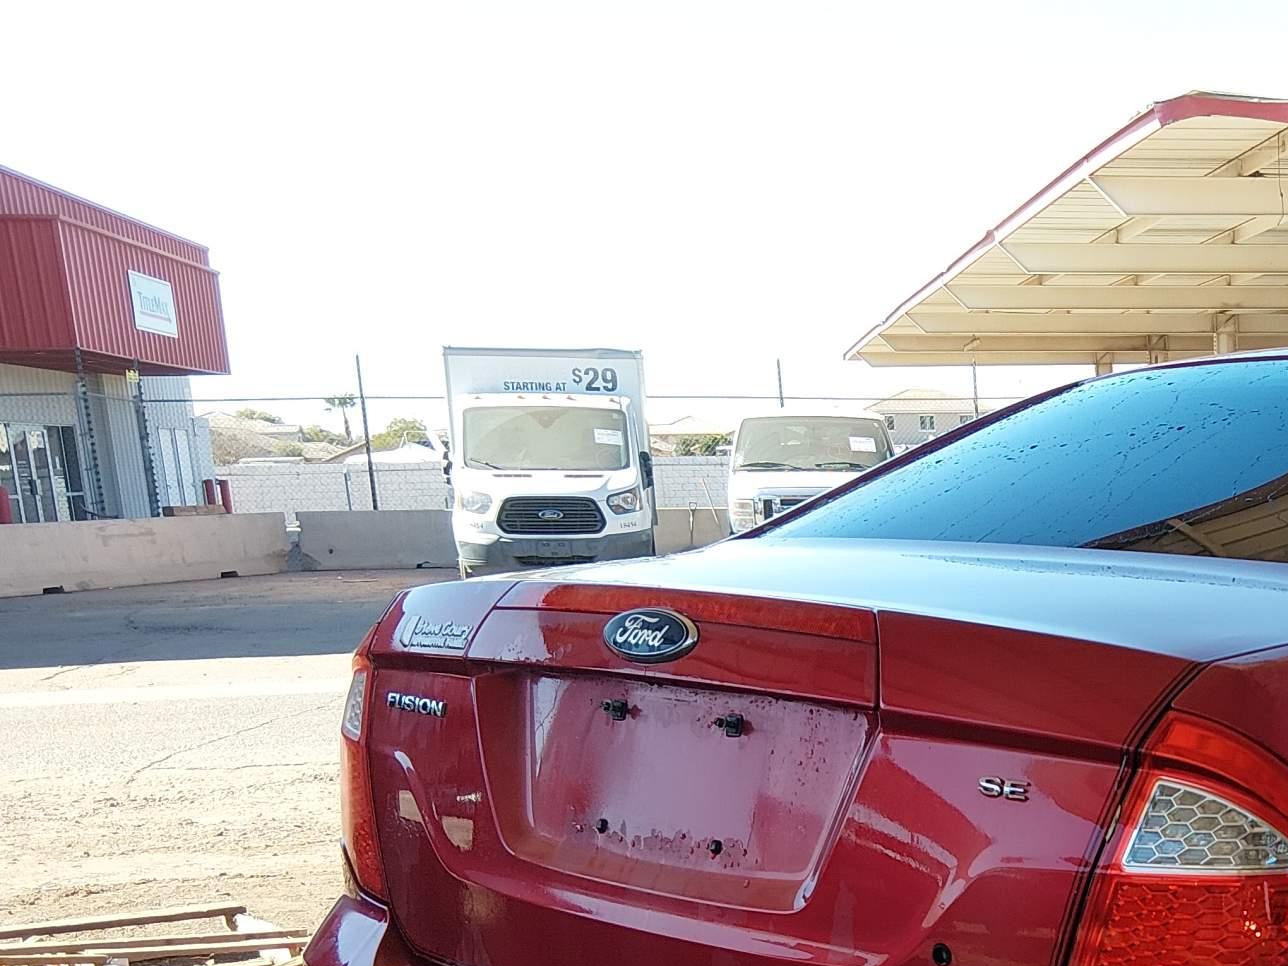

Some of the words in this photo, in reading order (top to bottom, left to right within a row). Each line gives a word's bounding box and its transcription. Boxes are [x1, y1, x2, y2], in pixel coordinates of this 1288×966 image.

[503, 381, 552, 392] STARTING
[555, 382, 567, 392] AT
[571, 367, 618, 392] $29
[615, 614, 670, 648] Ford
[386, 691, 447, 719] FUSION
[977, 775, 1031, 802] SE
